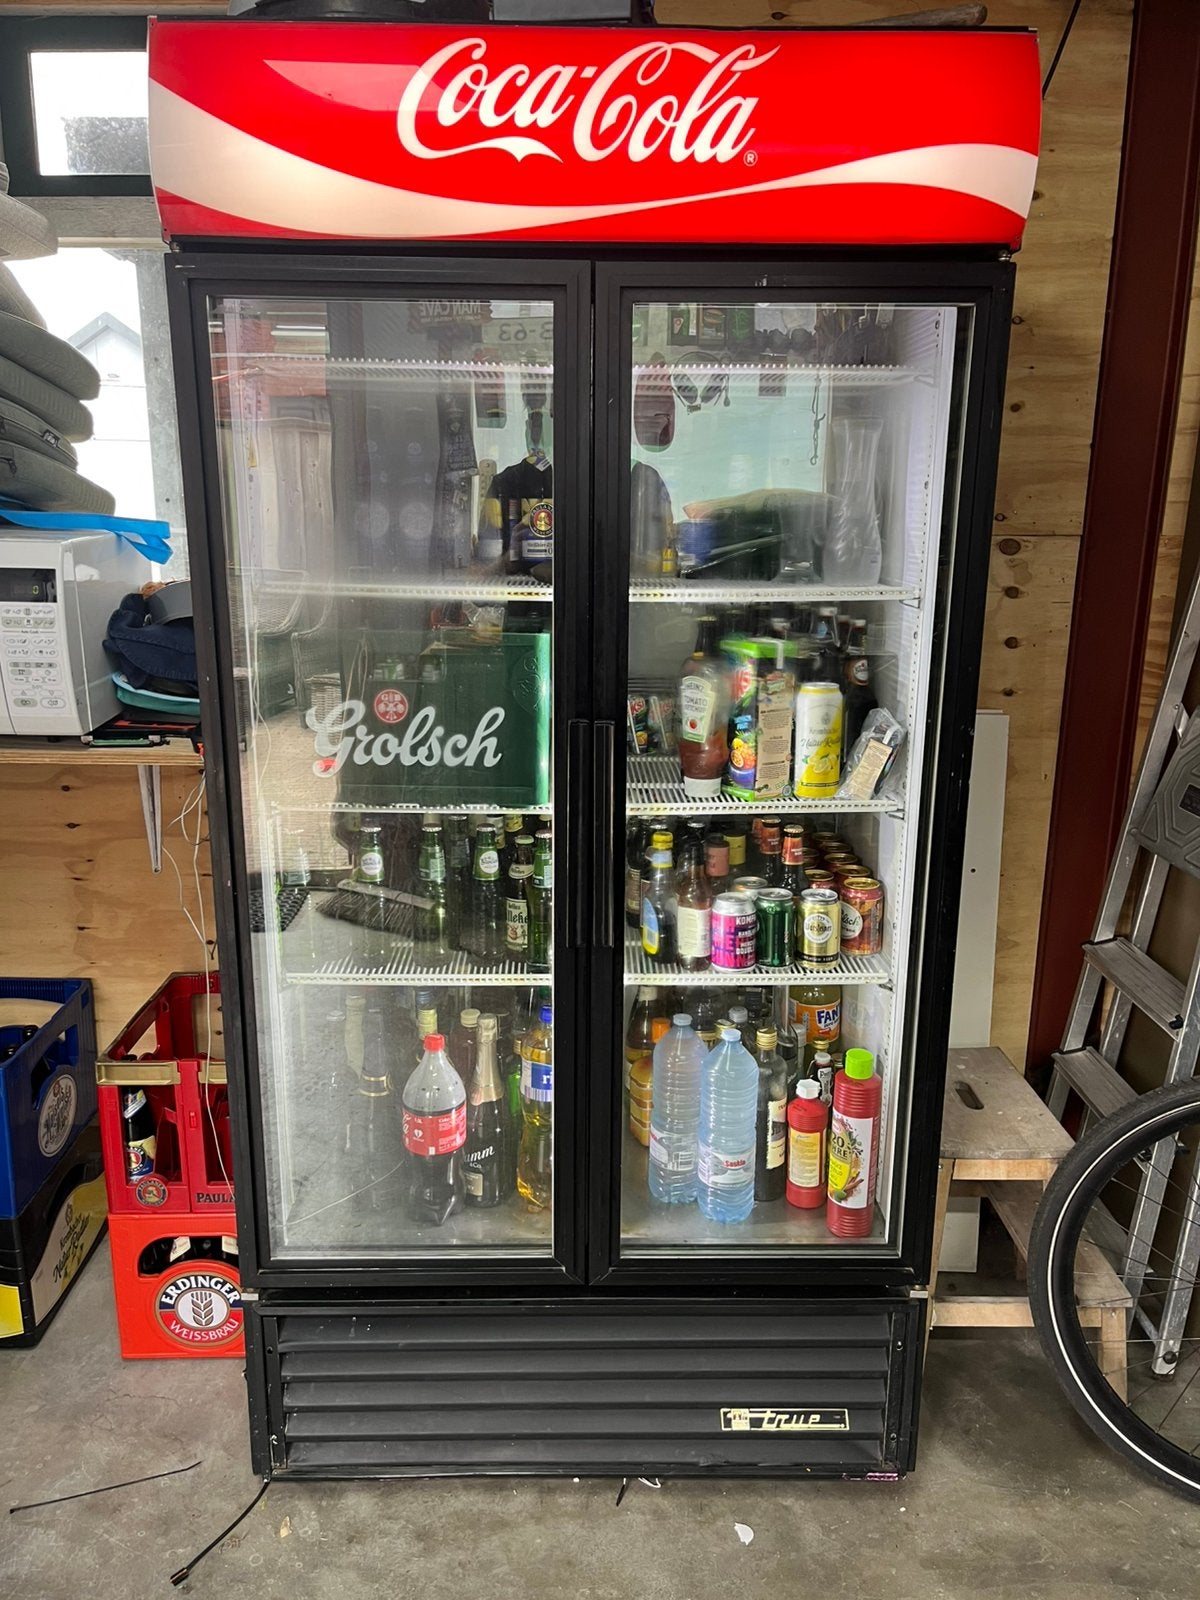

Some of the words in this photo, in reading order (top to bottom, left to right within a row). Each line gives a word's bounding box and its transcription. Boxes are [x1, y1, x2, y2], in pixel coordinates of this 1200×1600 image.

[397, 37, 781, 164] Coca-Cola
[305, 699, 506, 778] Grolsch
[160, 1275, 241, 1305] ERDINGER
